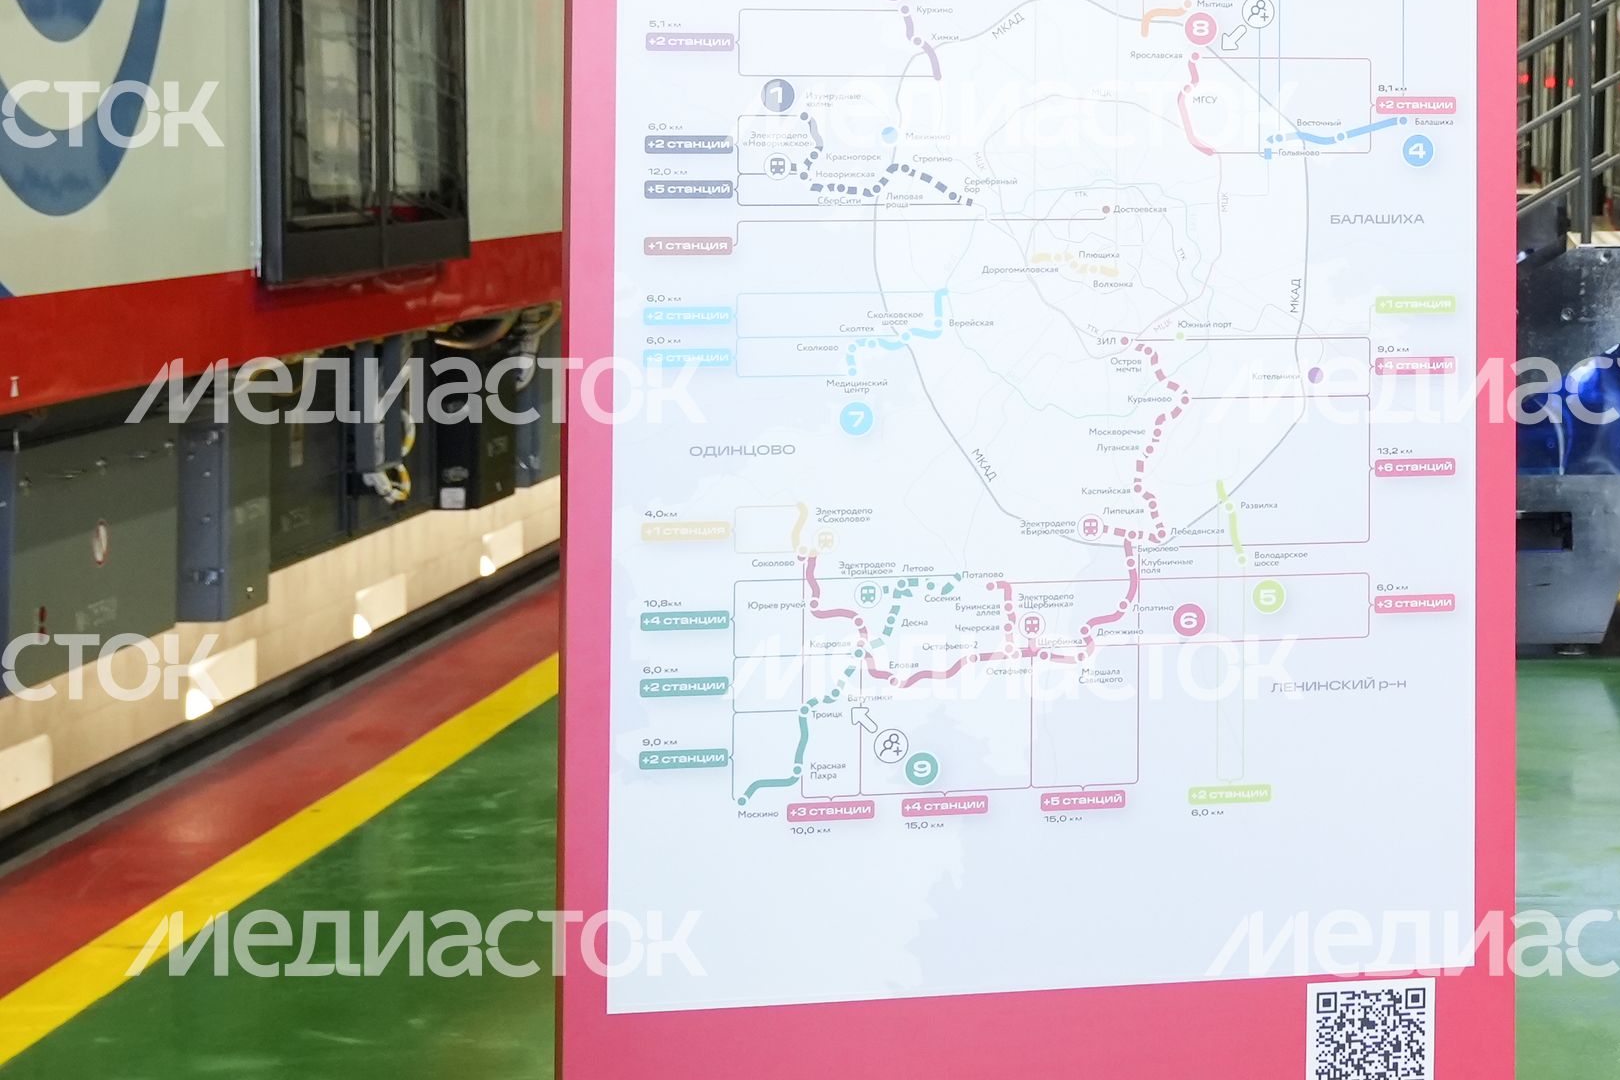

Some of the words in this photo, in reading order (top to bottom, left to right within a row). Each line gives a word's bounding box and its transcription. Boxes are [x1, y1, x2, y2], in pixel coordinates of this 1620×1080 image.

[1197, 0, 1233, 9] Мытищи
[916, 5, 954, 15] Куркино
[991, 11, 1026, 40] МКАД
[1192, 20, 1210, 37] 8
[931, 33, 960, 41] Химки
[648, 37, 665, 46] +2
[667, 37, 731, 48] станции
[1129, 50, 1183, 60] Ярославская
[770, 86, 784, 103] 1
[1192, 95, 1217, 104] МГСУ
[1379, 100, 1394, 109] +2
[1396, 100, 1453, 111] станции
[1296, 118, 1342, 127] Восточный
[1414, 118, 1454, 127] Балашиха
[648, 139, 663, 148] +2
[666, 139, 730, 150] станции
[1408, 143, 1426, 159] 4
[826, 152, 882, 163] Красногорск
[912, 154, 953, 164] Строгино
[815, 170, 875, 180] Новорижская
[964, 176, 1018, 187] Серебряный
[648, 185, 663, 194] +5
[666, 183, 730, 195] станций
[964, 185, 980, 195] бор
[886, 192, 924, 202] Липовая
[1113, 204, 1167, 215] Достоевская
[1330, 214, 1425, 225] БАЛАШИХА
[648, 241, 663, 250] +1
[665, 241, 728, 251] станция
[1078, 251, 1120, 261] Плющиха
[982, 265, 1059, 276] Дорогомиловская
[1093, 280, 1133, 290] Волхонка
[1290, 278, 1302, 313] МКАД
[1379, 300, 1393, 308] +1
[1393, 299, 1451, 310] станция
[647, 311, 663, 320] +2
[666, 311, 729, 322] станции
[866, 310, 923, 320] Сколковское
[949, 319, 994, 329] Верейская
[1177, 320, 1210, 330] Южный
[1212, 321, 1233, 329] порт
[1096, 337, 1116, 346] ЗИЛ
[796, 343, 839, 353] Сколково
[1110, 357, 1142, 368] Остров
[1377, 361, 1393, 370] +4
[1396, 360, 1453, 371] станции
[826, 379, 887, 389] Медицинский
[844, 386, 870, 395] центр
[1127, 395, 1172, 405] Курьяново
[846, 410, 865, 427] 7
[1088, 427, 1146, 437] Москворечье
[689, 444, 796, 458] ОДИНЦОВО
[1096, 443, 1140, 453] Луганская
[971, 448, 997, 483] МКАД
[1378, 464, 1393, 472] +6
[1395, 461, 1453, 474] станций
[1081, 486, 1131, 496] Каспийская
[1240, 500, 1278, 510] Развилка
[815, 506, 873, 517] Электродепо
[1102, 507, 1144, 517] Липецкая
[1019, 519, 1076, 529] Электродепо
[646, 528, 660, 536] +1
[663, 526, 726, 537] станция
[1170, 527, 1225, 536] Лебедянская
[1137, 544, 1179, 553] Бирюлево
[1254, 550, 1308, 560] Володарское
[751, 559, 795, 568] Соколово
[1141, 558, 1194, 567] Клубничные
[902, 564, 935, 574] Летово
[961, 569, 1004, 579] Потапово
[1140, 566, 1162, 575] поля
[924, 594, 961, 604] Сосенки
[1018, 592, 1074, 603] Электродепо
[1259, 589, 1277, 605] 5
[747, 600, 778, 611] Юрьев
[779, 599, 806, 610] ручей
[955, 603, 1001, 612] Бунинская
[1132, 603, 1174, 613] Лопатино
[1378, 599, 1393, 608] +3
[1395, 598, 1452, 609] станции
[643, 617, 660, 626] +4
[663, 615, 726, 626] станции
[901, 618, 928, 628] Десна
[1180, 611, 1198, 627] 6
[954, 623, 1000, 633] Чечерская
[889, 660, 919, 670] Еловая
[643, 683, 659, 692] +2
[662, 681, 725, 693] станции
[1270, 676, 1376, 693] ЛЕНИНСКИЙ
[1378, 678, 1407, 691] р-н
[811, 710, 843, 720] Троицк
[642, 755, 659, 764] +2
[662, 753, 725, 765] станции
[810, 762, 846, 771] Красная
[913, 760, 929, 777] 9
[809, 771, 837, 780] Пахра
[1043, 796, 1060, 806] +5
[1062, 793, 1122, 806] станций
[1191, 791, 1207, 800] +2
[1209, 789, 1268, 800] станции
[790, 807, 808, 817] +3
[810, 804, 871, 817] станции
[904, 802, 921, 812] +4
[924, 800, 985, 812] станции
[737, 809, 779, 819] Москино
